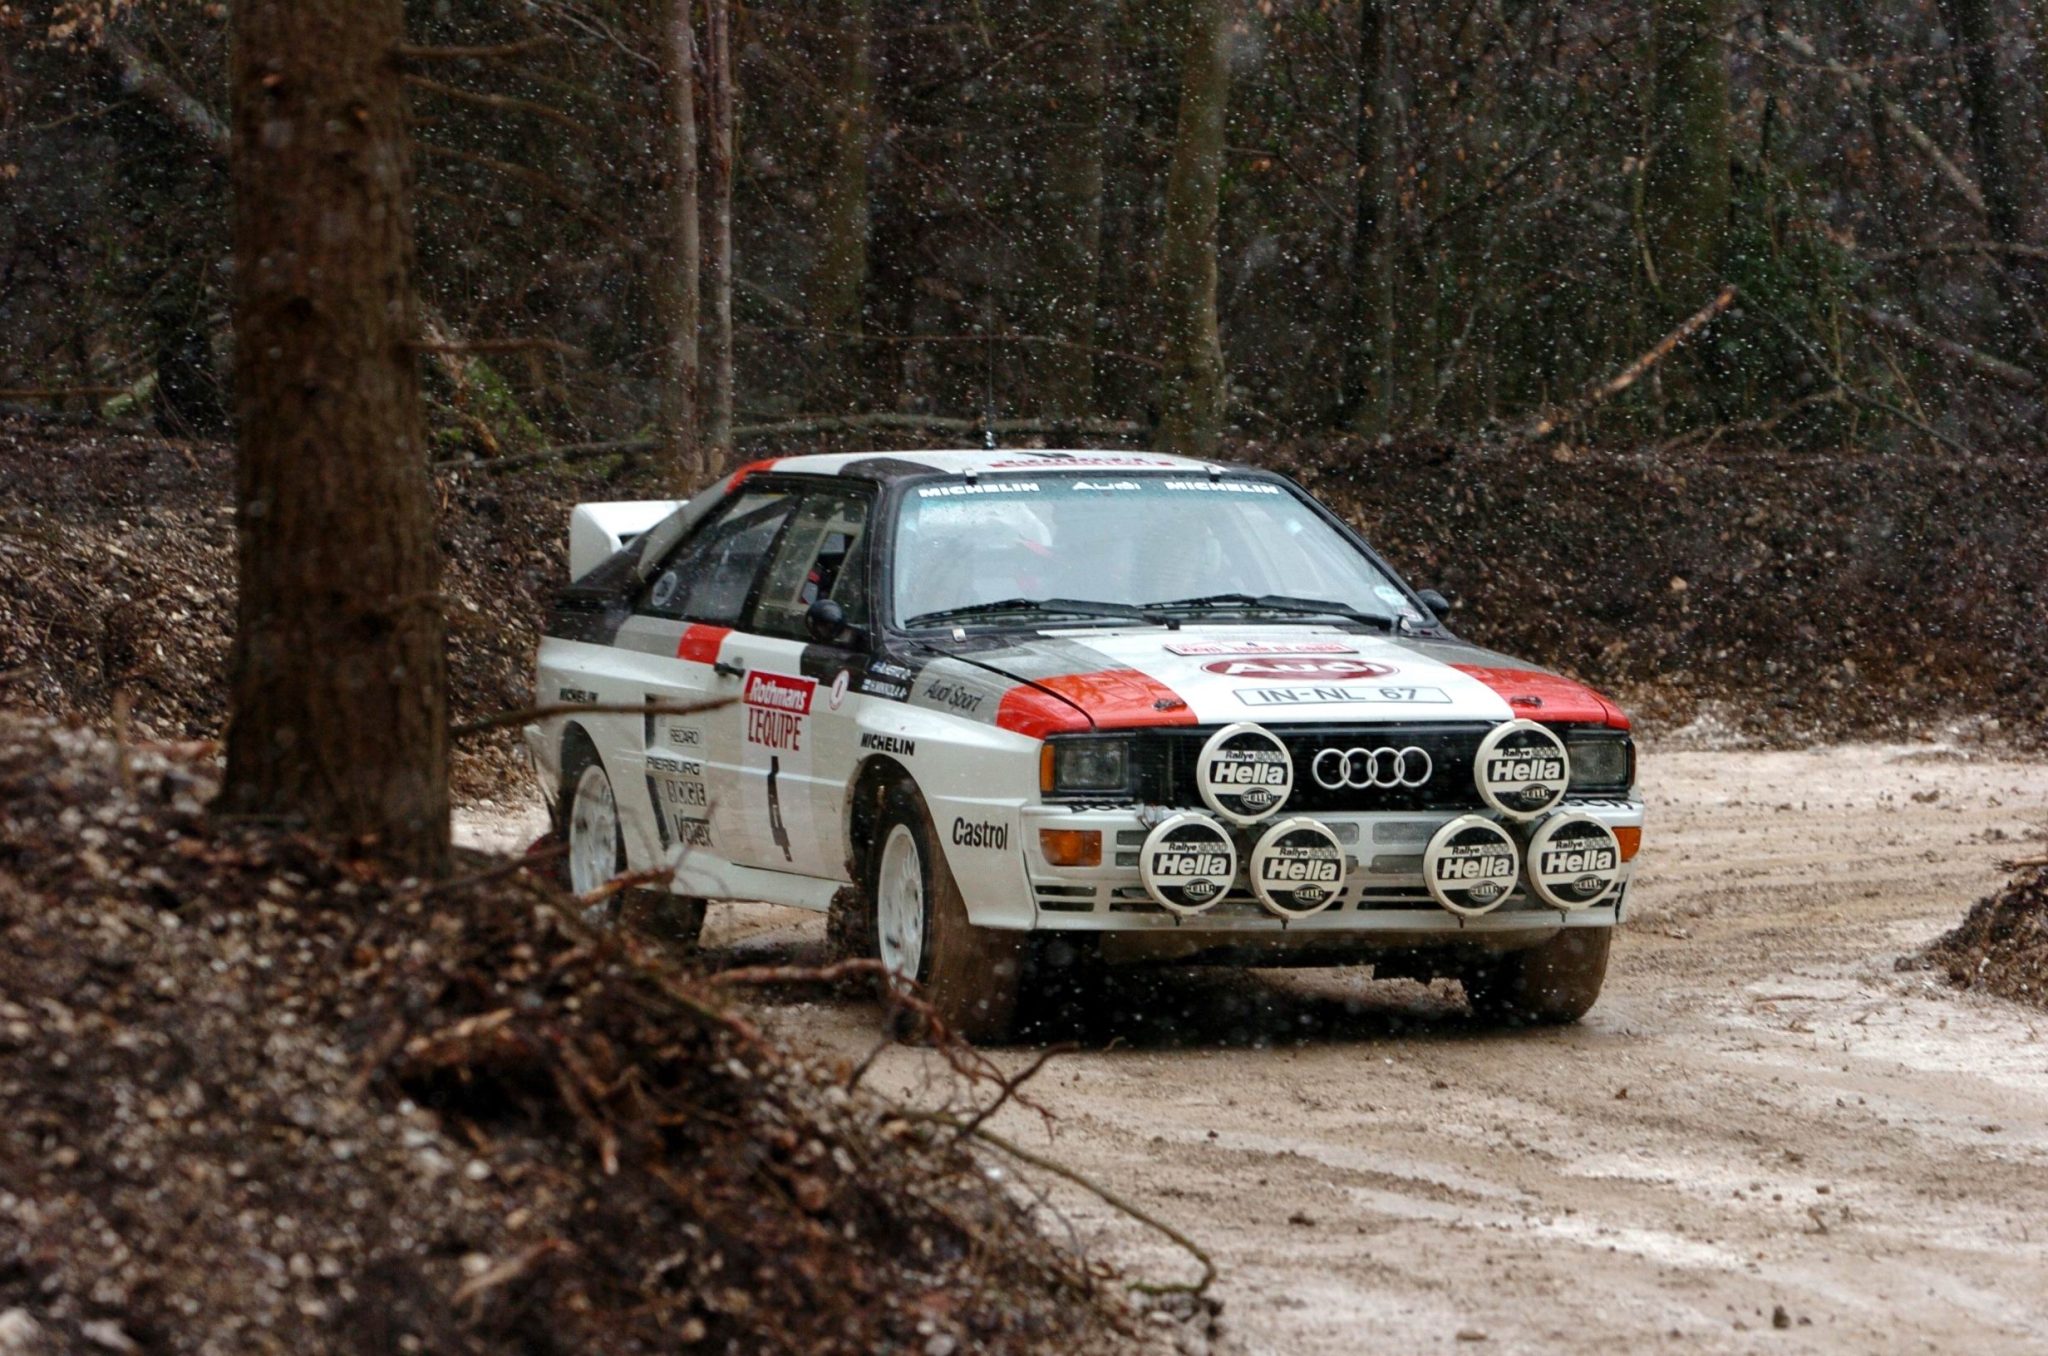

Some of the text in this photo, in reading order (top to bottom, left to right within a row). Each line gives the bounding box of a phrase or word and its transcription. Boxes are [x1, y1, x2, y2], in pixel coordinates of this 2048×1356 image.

[918, 482, 1040, 498] MICHELIN
[1165, 480, 1279, 495] MICHELIN
[750, 676, 808, 711] Rothmans
[1257, 687, 1418, 702] IN-NL 67
[860, 732, 916, 757] MICHELIN
[646, 757, 700, 776] PIERBURG
[1214, 762, 1284, 784] Hella
[1492, 759, 1561, 781] Hella
[952, 816, 1009, 851] Castrol
[1157, 854, 1227, 875] Hella
[1267, 859, 1337, 880] Hella
[1442, 856, 1510, 879] Hella
[1545, 850, 1612, 874] Hella
